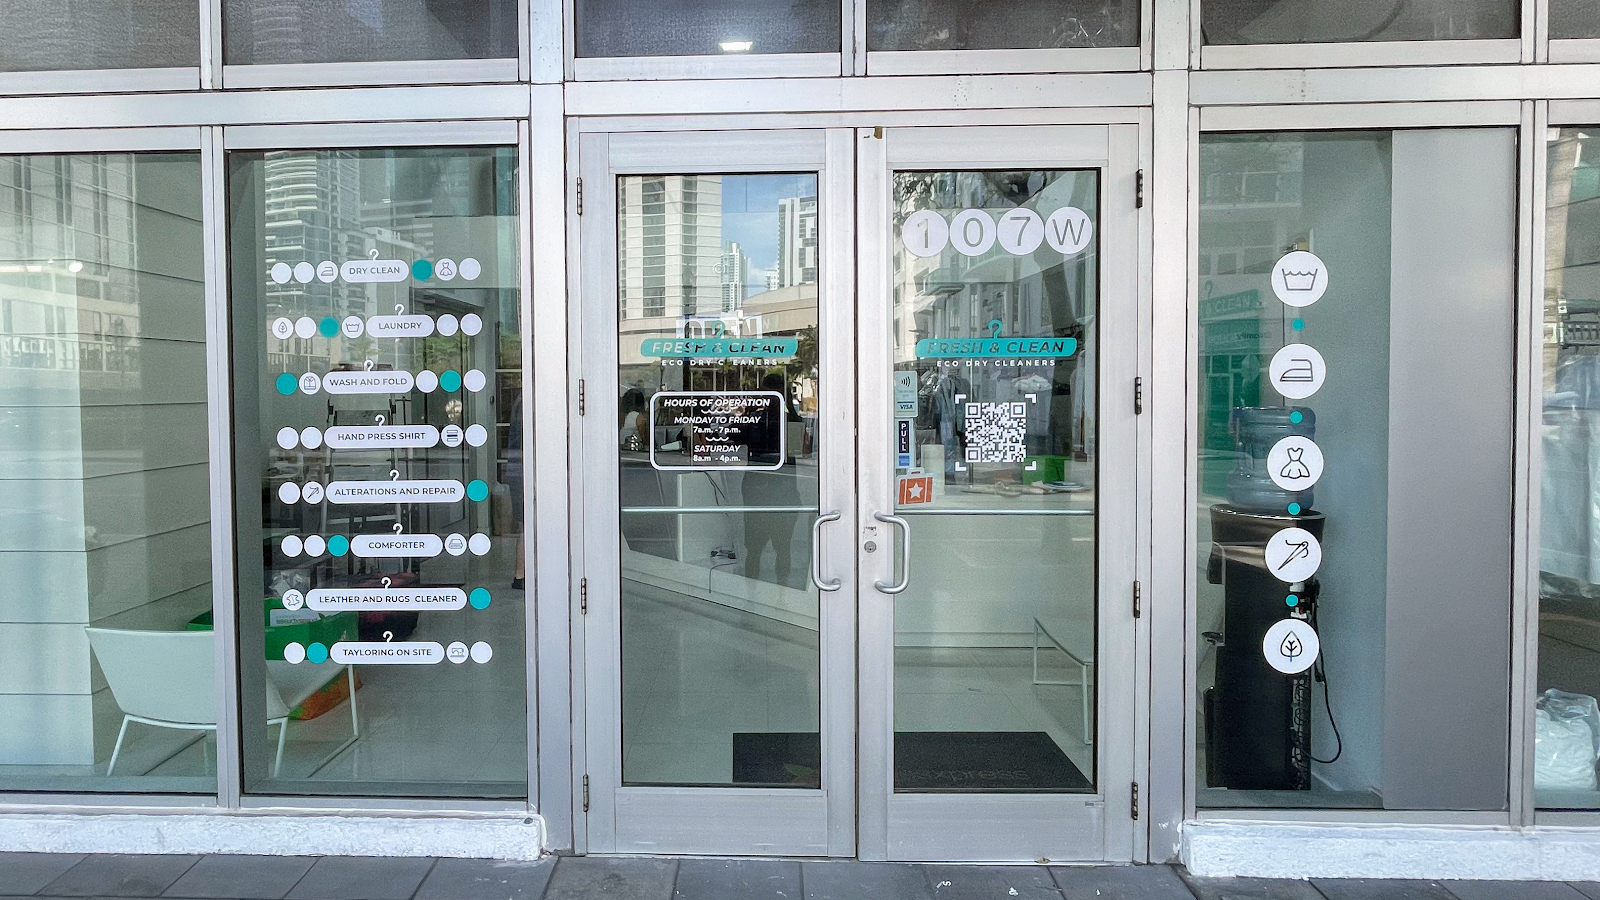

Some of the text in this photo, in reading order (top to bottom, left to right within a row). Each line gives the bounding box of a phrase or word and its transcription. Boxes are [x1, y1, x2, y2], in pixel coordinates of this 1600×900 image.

[349, 266, 400, 275] DRY CLEAN
[378, 322, 422, 330] LAUNDRY
[652, 341, 706, 354] FRESH
[729, 341, 786, 354] CLEAN
[927, 341, 1065, 355] FRESH & CLEAN
[661, 359, 778, 367] ECO DRY CEANERS
[965, 360, 989, 368] DRY
[994, 359, 1056, 368] CLEANERS
[329, 378, 408, 387] WASH AND FOLD
[664, 398, 771, 408] HOURS OF OPERATION
[674, 416, 761, 425] MONDAY TO FRIDAY
[338, 432, 426, 441] HAND PRESS SHIRT
[694, 444, 741, 453] SATURDAY
[719, 454, 741, 464] 4p.m.
[334, 487, 456, 496] ALTERATIONS AND REPAIR
[368, 541, 425, 549] COMFORTER
[319, 595, 458, 604] LEATHER AND RUGS CLEANER
[342, 648, 432, 656] TAYLORING ON SITE
